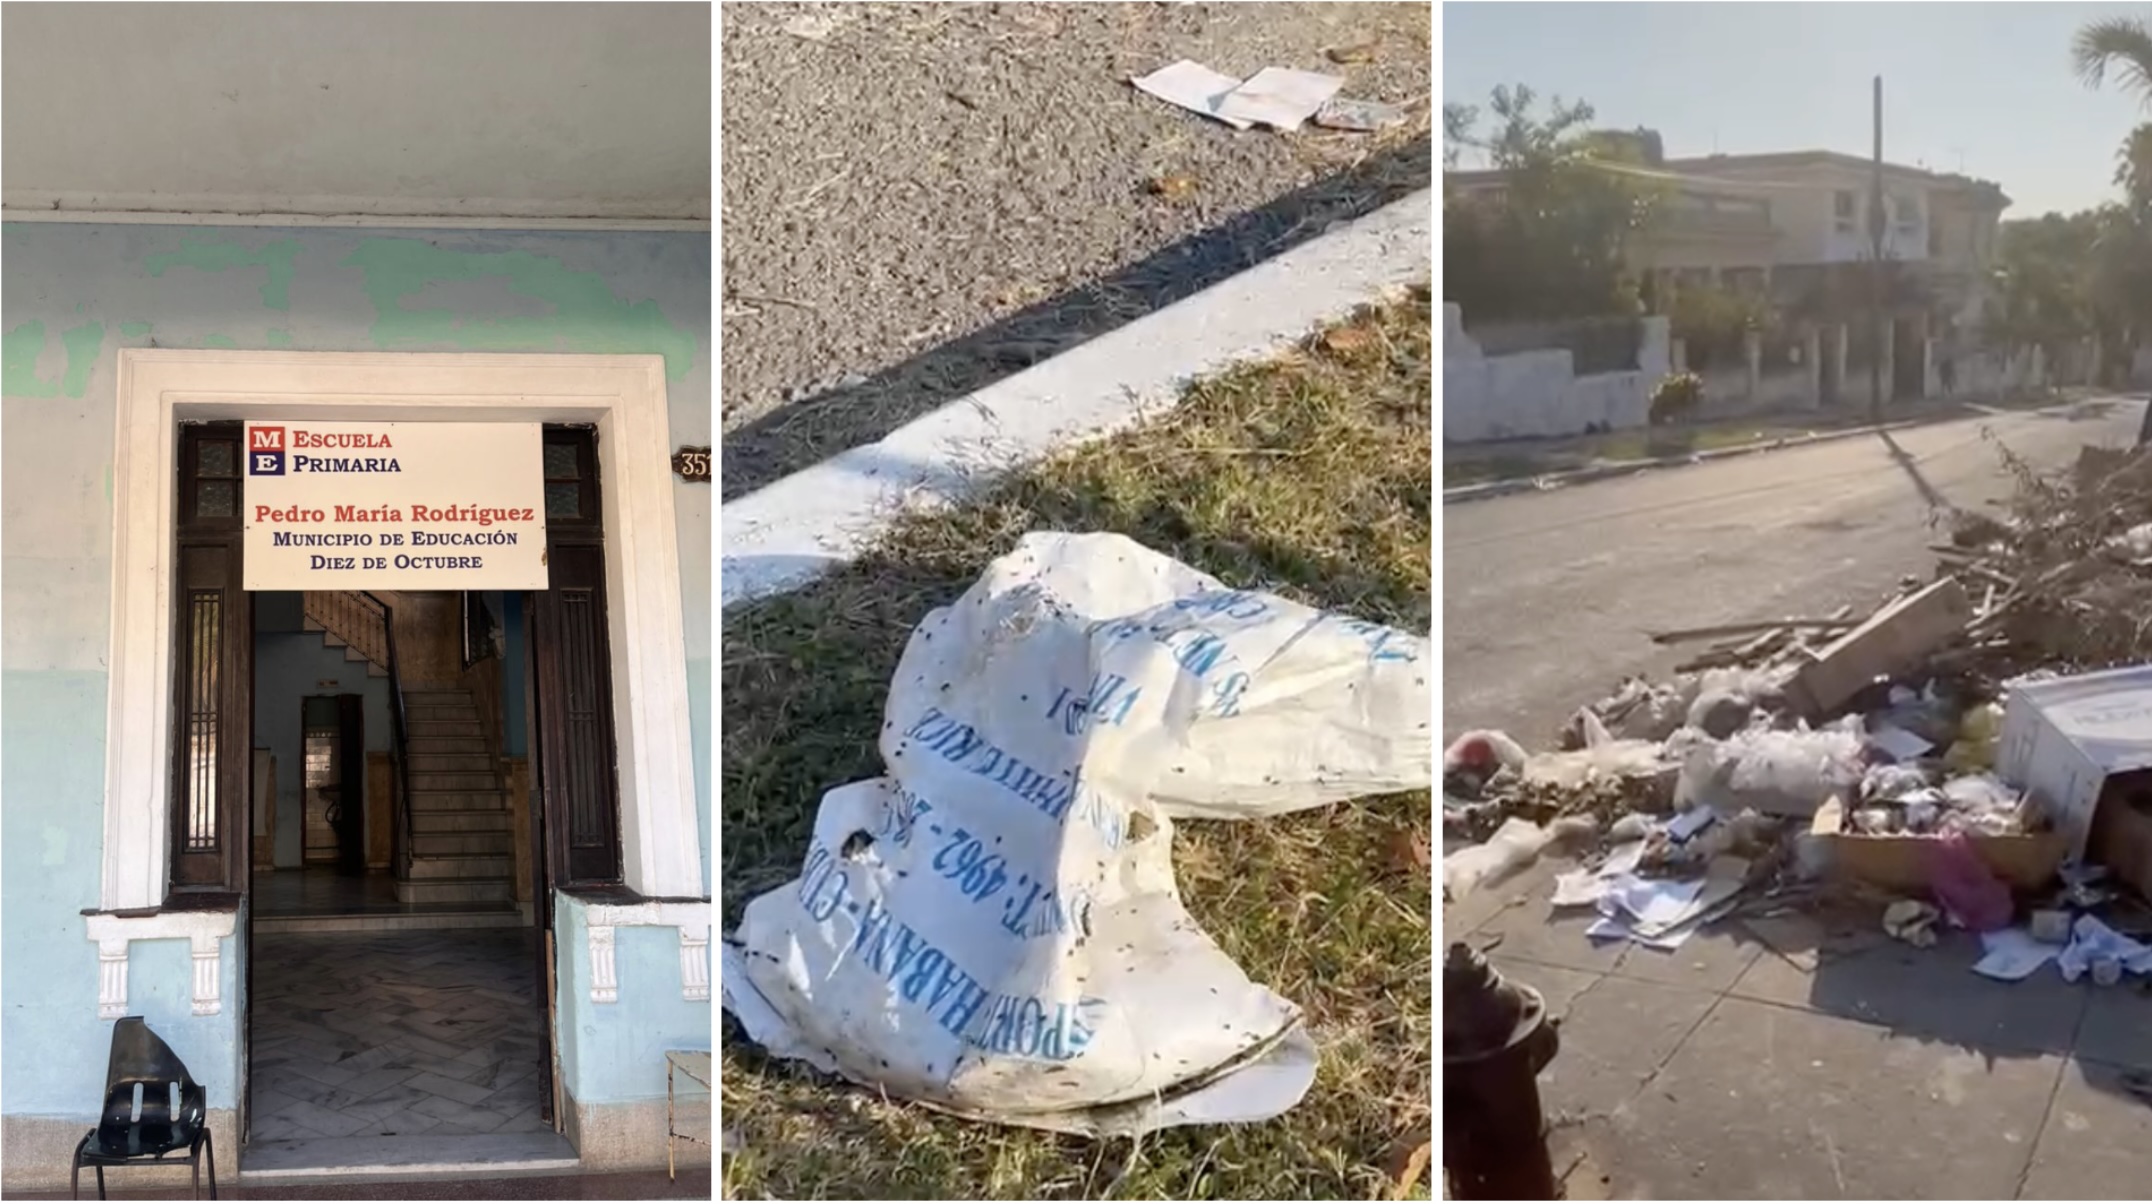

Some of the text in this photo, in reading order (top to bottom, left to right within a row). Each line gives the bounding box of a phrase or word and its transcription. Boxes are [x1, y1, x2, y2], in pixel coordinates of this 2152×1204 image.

[253, 431, 281, 448] M
[292, 430, 393, 449] ESCUELA
[255, 454, 279, 472] E
[292, 455, 402, 473] PRIMARIA
[681, 453, 711, 475] 35
[255, 503, 535, 526] Pedro María Rodríguez
[272, 531, 373, 547] MUNICIPIO
[411, 529, 518, 546] EDUCACIÓN
[310, 554, 356, 570] DIEZ
[394, 554, 483, 570] OCTUBRE
